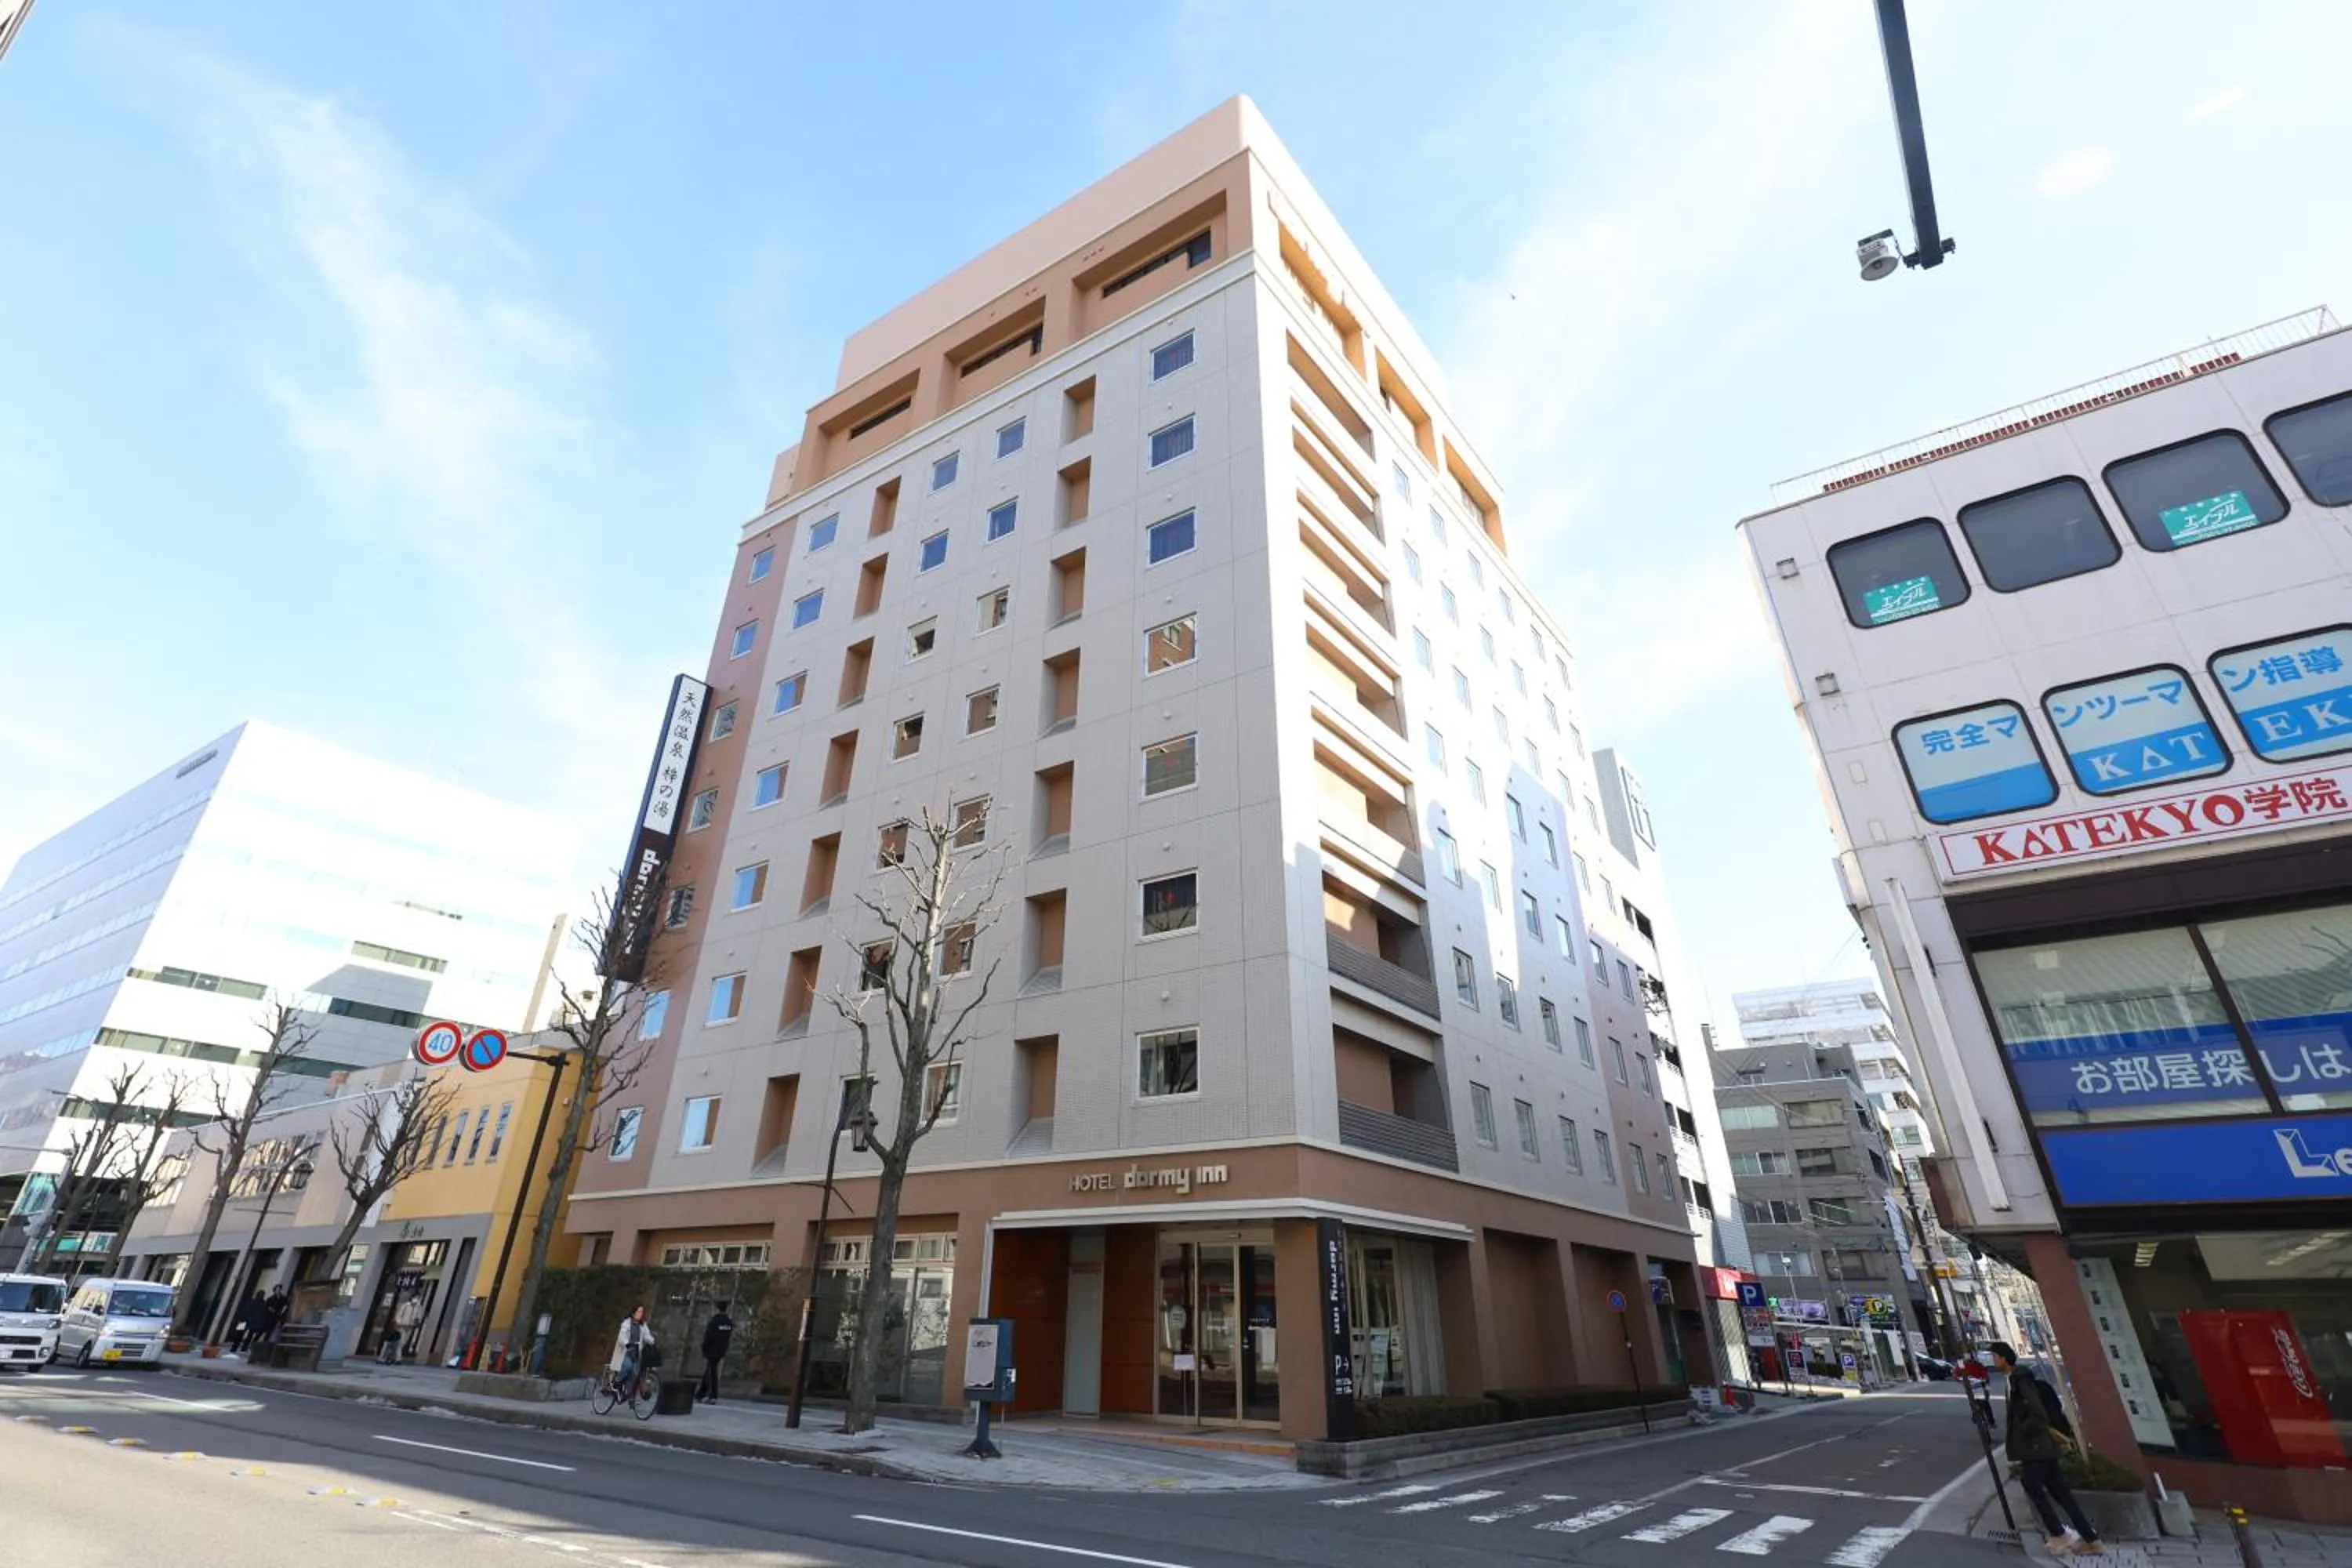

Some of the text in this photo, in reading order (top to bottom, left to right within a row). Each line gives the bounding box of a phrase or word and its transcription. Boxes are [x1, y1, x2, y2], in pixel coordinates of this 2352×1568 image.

[2252, 695, 2352, 742] EK
[428, 1033, 452, 1052] 40
[1069, 1174, 1117, 1191] HOTEL
[1123, 1163, 1190, 1194] dormy
[1742, 1284, 1757, 1305] P
[1335, 1355, 1341, 1375] P
